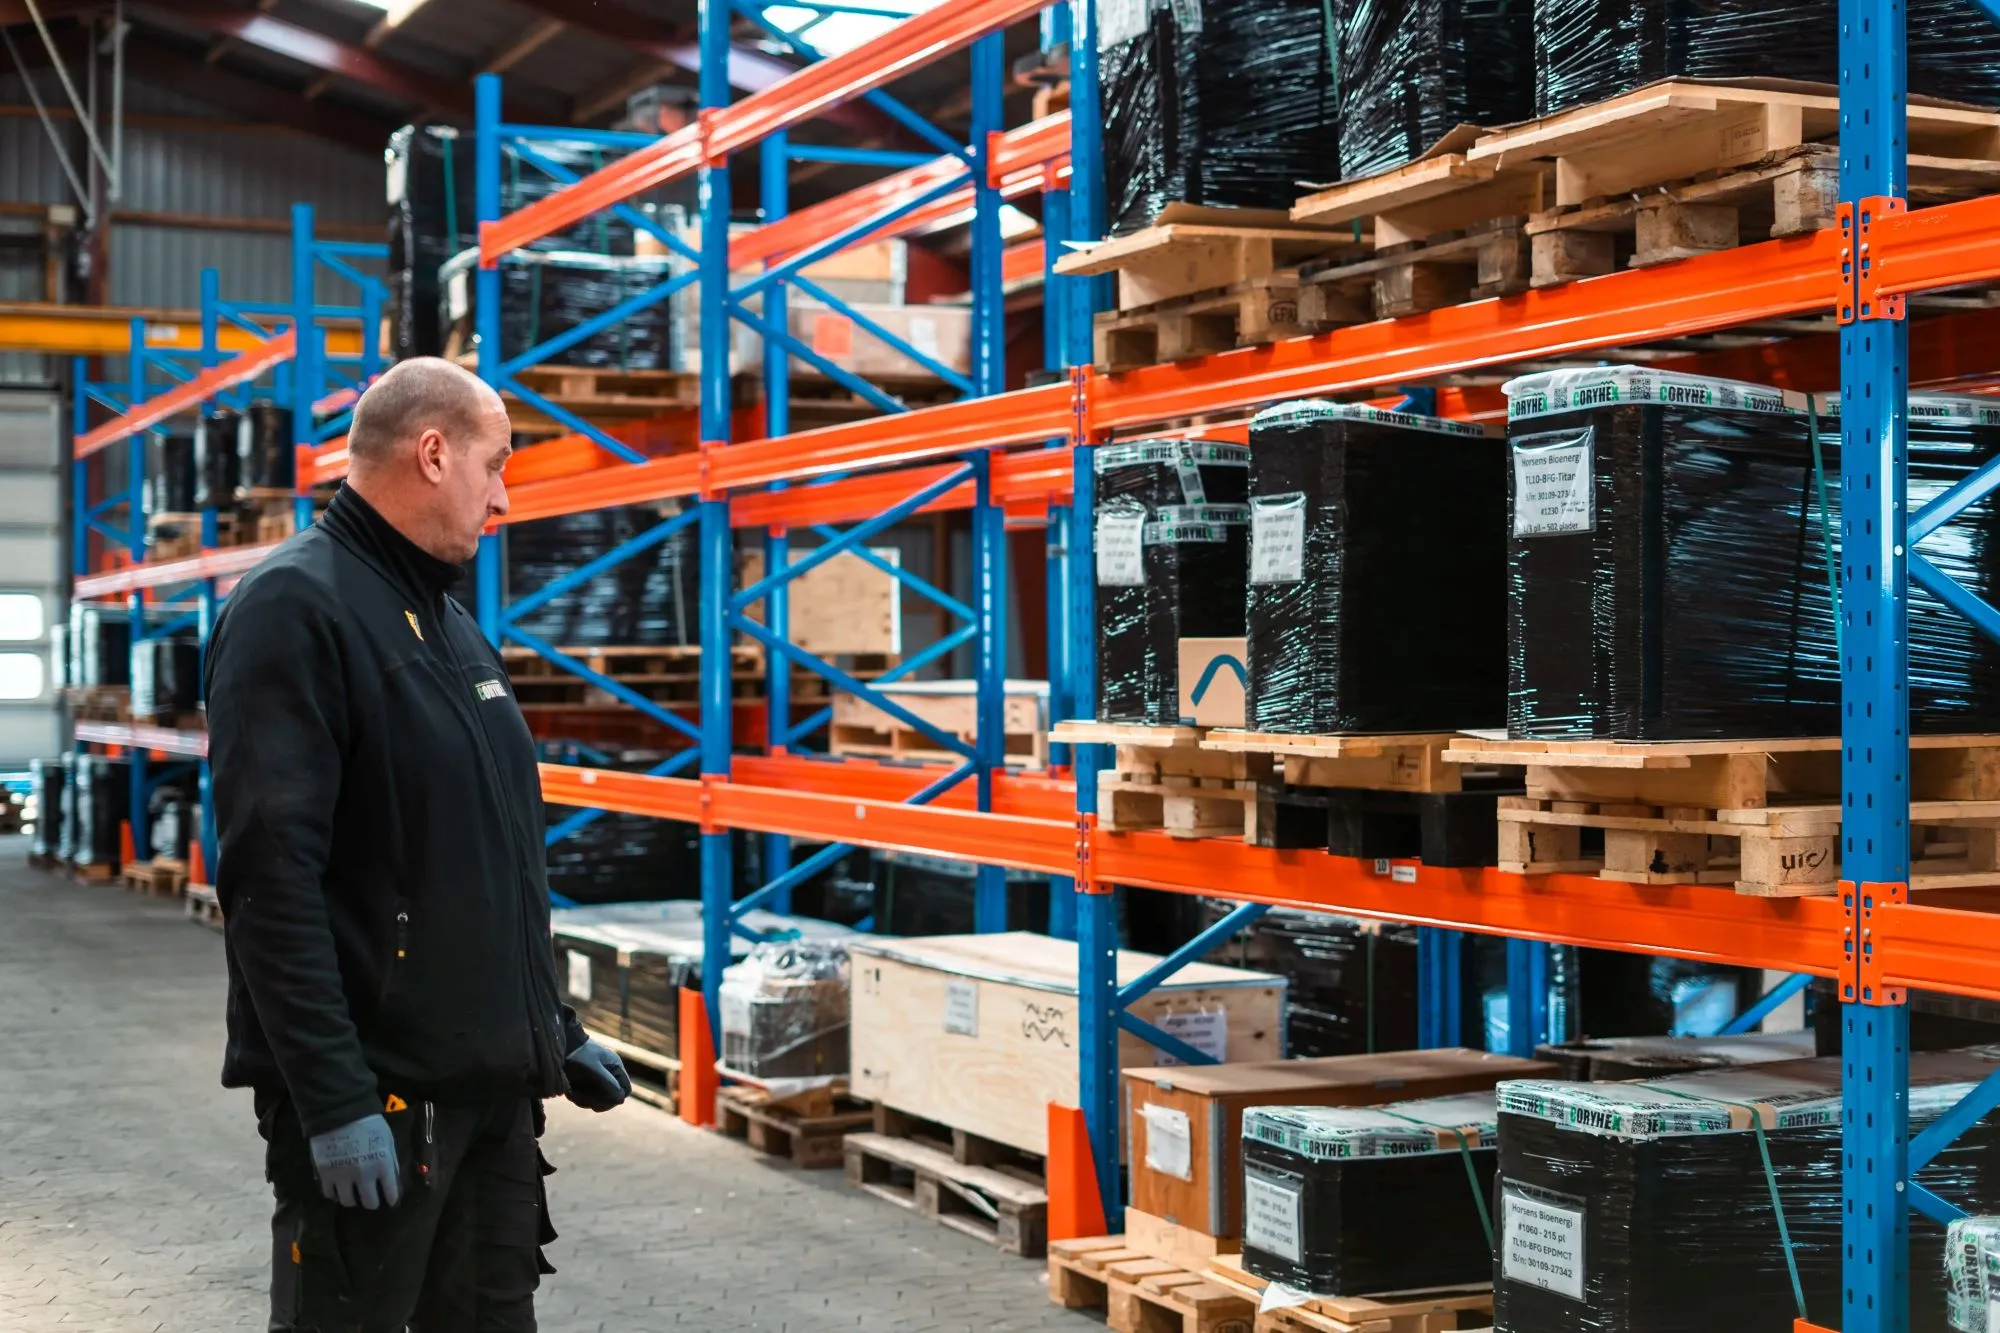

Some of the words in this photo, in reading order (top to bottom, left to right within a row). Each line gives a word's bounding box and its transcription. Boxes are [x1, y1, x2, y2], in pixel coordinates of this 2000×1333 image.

[1573, 383, 1619, 407] CORYHEX
[1659, 386, 1712, 405] CORYHEX
[1521, 457, 1547, 467] Horsens
[1549, 452, 1582, 464] Bioenergi
[1570, 1106, 1622, 1132] CORYHEX
[1780, 1111, 1831, 1127] CORYHEX
[1257, 1124, 1285, 1145] CORYHEX
[1303, 1137, 1351, 1157] CORYHEX
[1511, 1203, 1538, 1219] Horsens
[1539, 1210, 1573, 1228] Bioenergi
[1518, 1223, 1538, 1236] #1060
[1543, 1229, 1557, 1241] 215
[1543, 1245, 1573, 1261] EPDMCT
[1512, 1253, 1527, 1265] S/n:
[1527, 1257, 1573, 1278] 30109-27342
